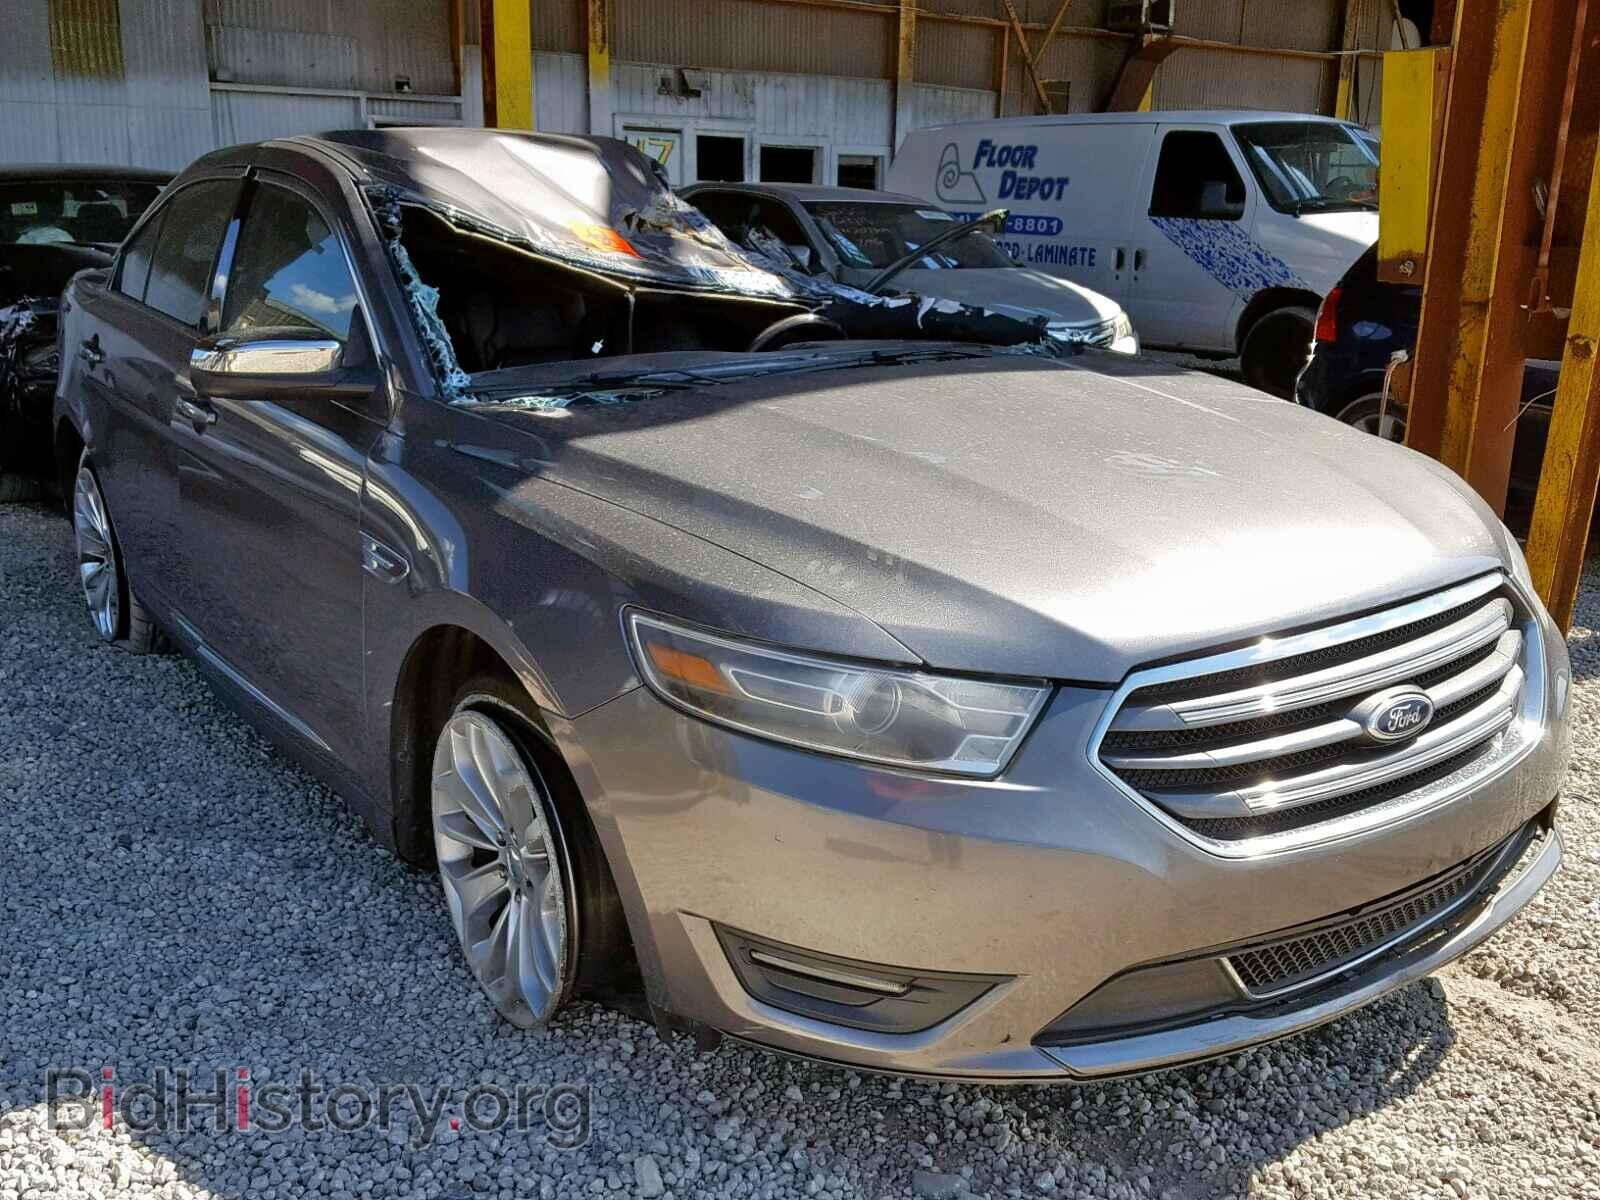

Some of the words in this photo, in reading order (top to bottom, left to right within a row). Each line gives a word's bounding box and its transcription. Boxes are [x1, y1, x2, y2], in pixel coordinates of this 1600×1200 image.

[973, 139, 1038, 169] FLOOR
[998, 170, 1070, 201] DEPOT
[1387, 703, 1421, 731] Ford
